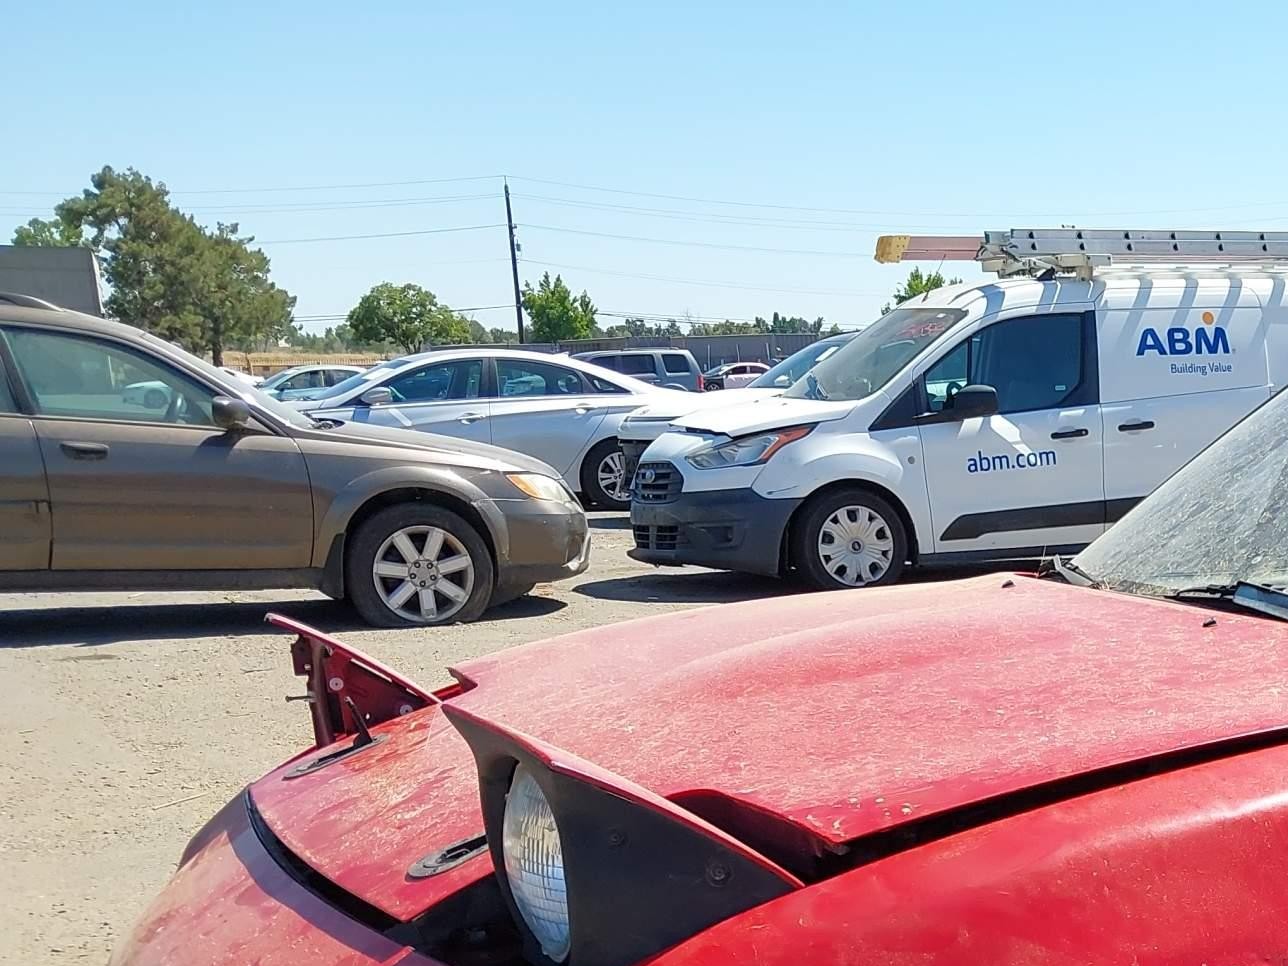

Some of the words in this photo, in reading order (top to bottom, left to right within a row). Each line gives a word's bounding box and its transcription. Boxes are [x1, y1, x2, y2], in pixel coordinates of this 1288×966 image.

[1135, 327, 1231, 357] ABM
[1170, 363, 1208, 376] Building
[1208, 362, 1233, 374] Value
[967, 450, 1057, 473] abm.com
